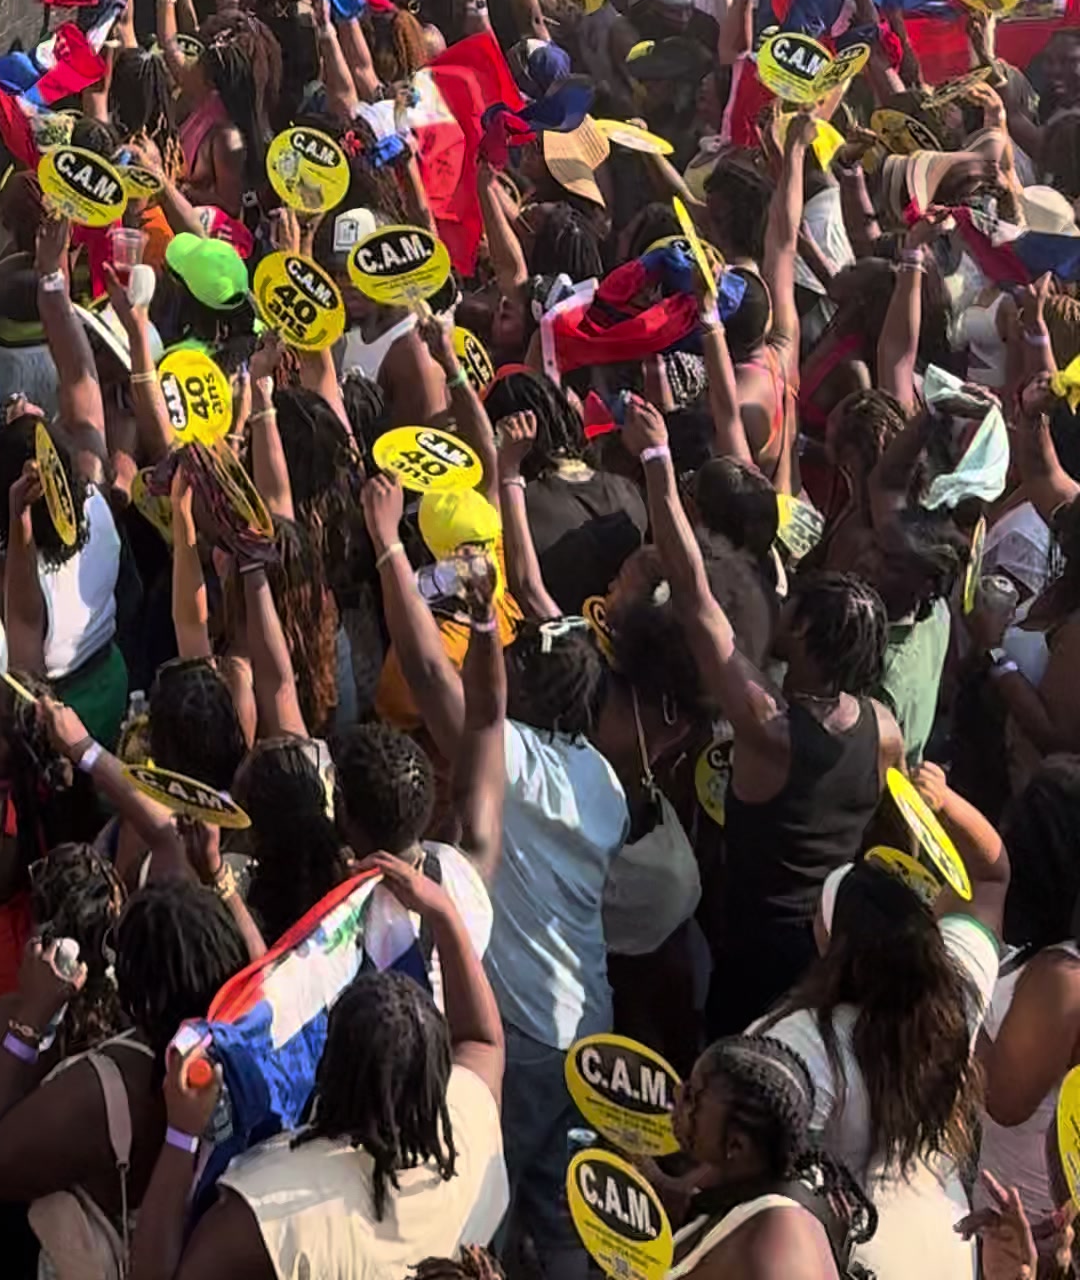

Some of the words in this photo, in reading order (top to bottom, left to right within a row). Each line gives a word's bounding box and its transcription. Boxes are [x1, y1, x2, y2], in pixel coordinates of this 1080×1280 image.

[56, 152, 119, 205] C.A.M.
[356, 233, 434, 273] C.A.M.
[274, 285, 317, 325] 40
[287, 261, 333, 307] C.A.M.
[267, 301, 308, 339] ans
[185, 376, 209, 420] 40
[390, 460, 433, 486] ans
[399, 450, 448, 476] 40
[581, 1047, 675, 1112] C.A.M.
[580, 1163, 658, 1238] C.A.M.
